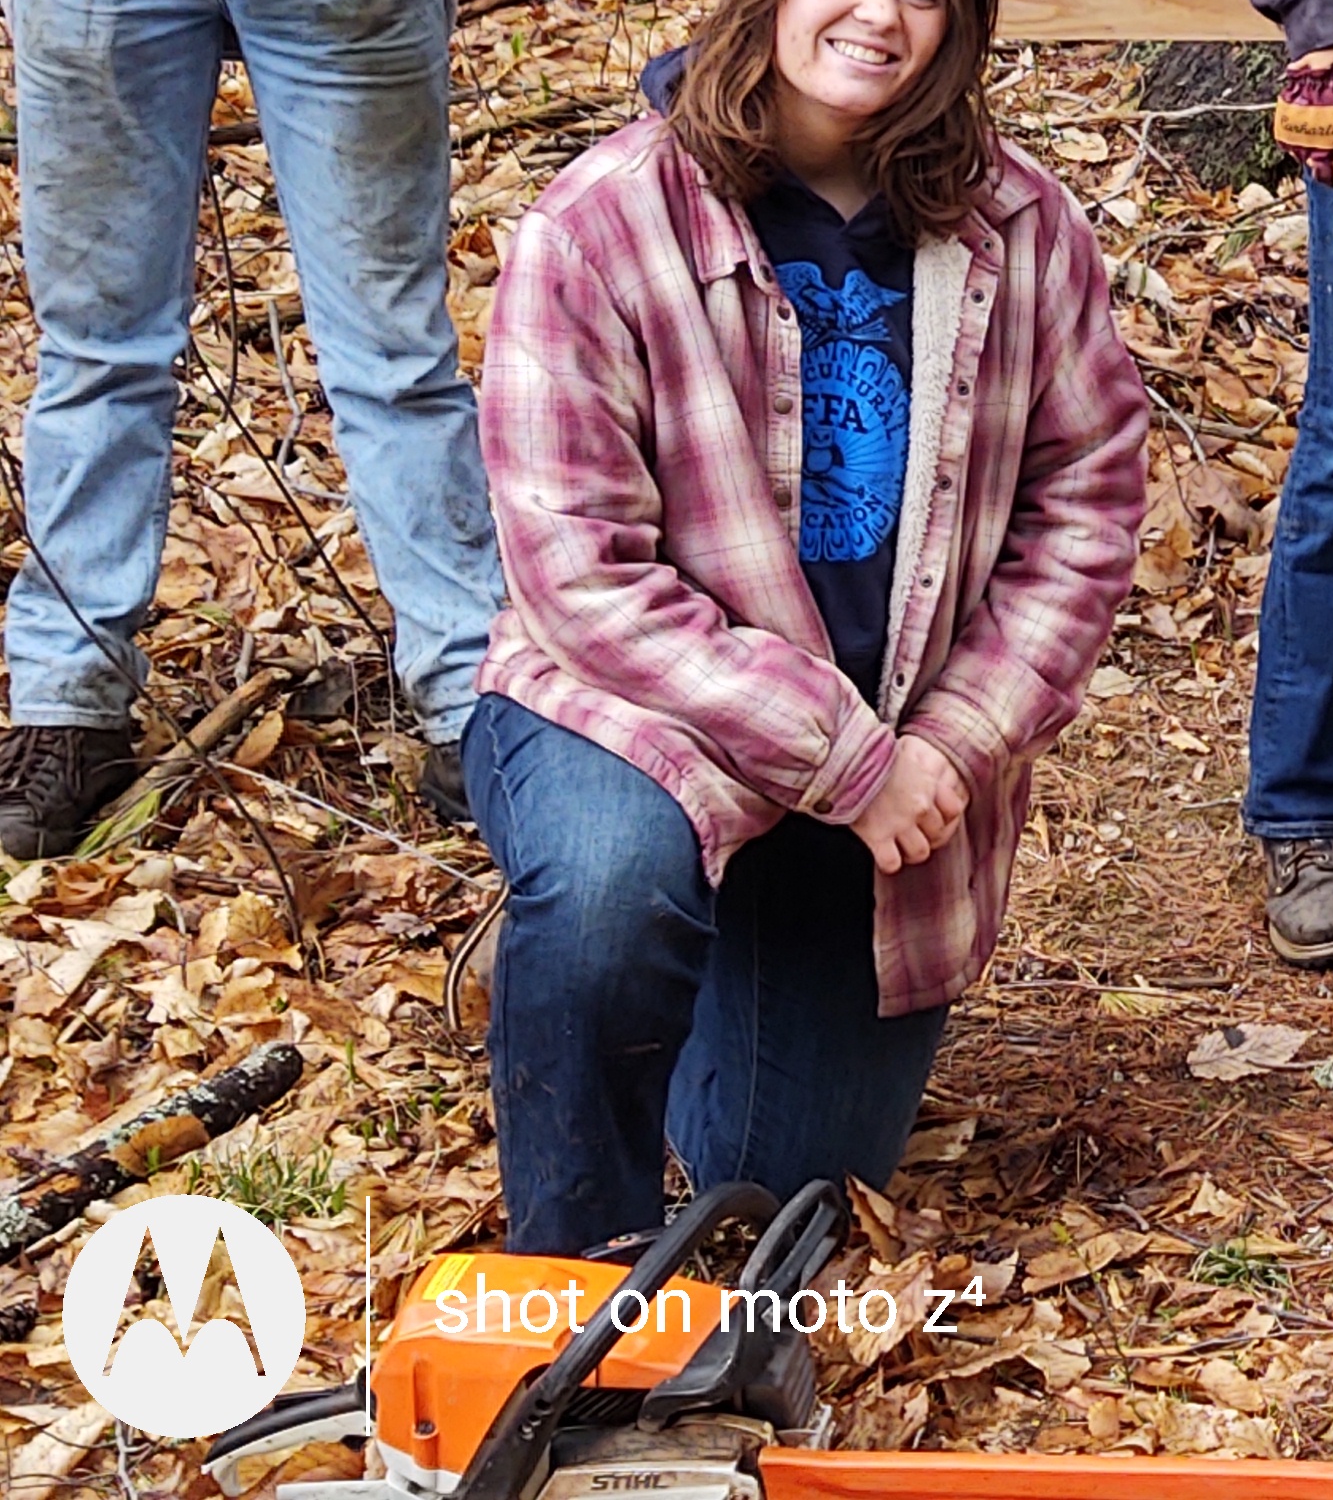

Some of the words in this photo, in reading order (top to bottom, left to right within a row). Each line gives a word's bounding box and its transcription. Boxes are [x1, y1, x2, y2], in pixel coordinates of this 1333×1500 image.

[803, 362, 898, 443] CULTURAL
[804, 493, 883, 529] CATION
[590, 1472, 669, 1491] STIHL
